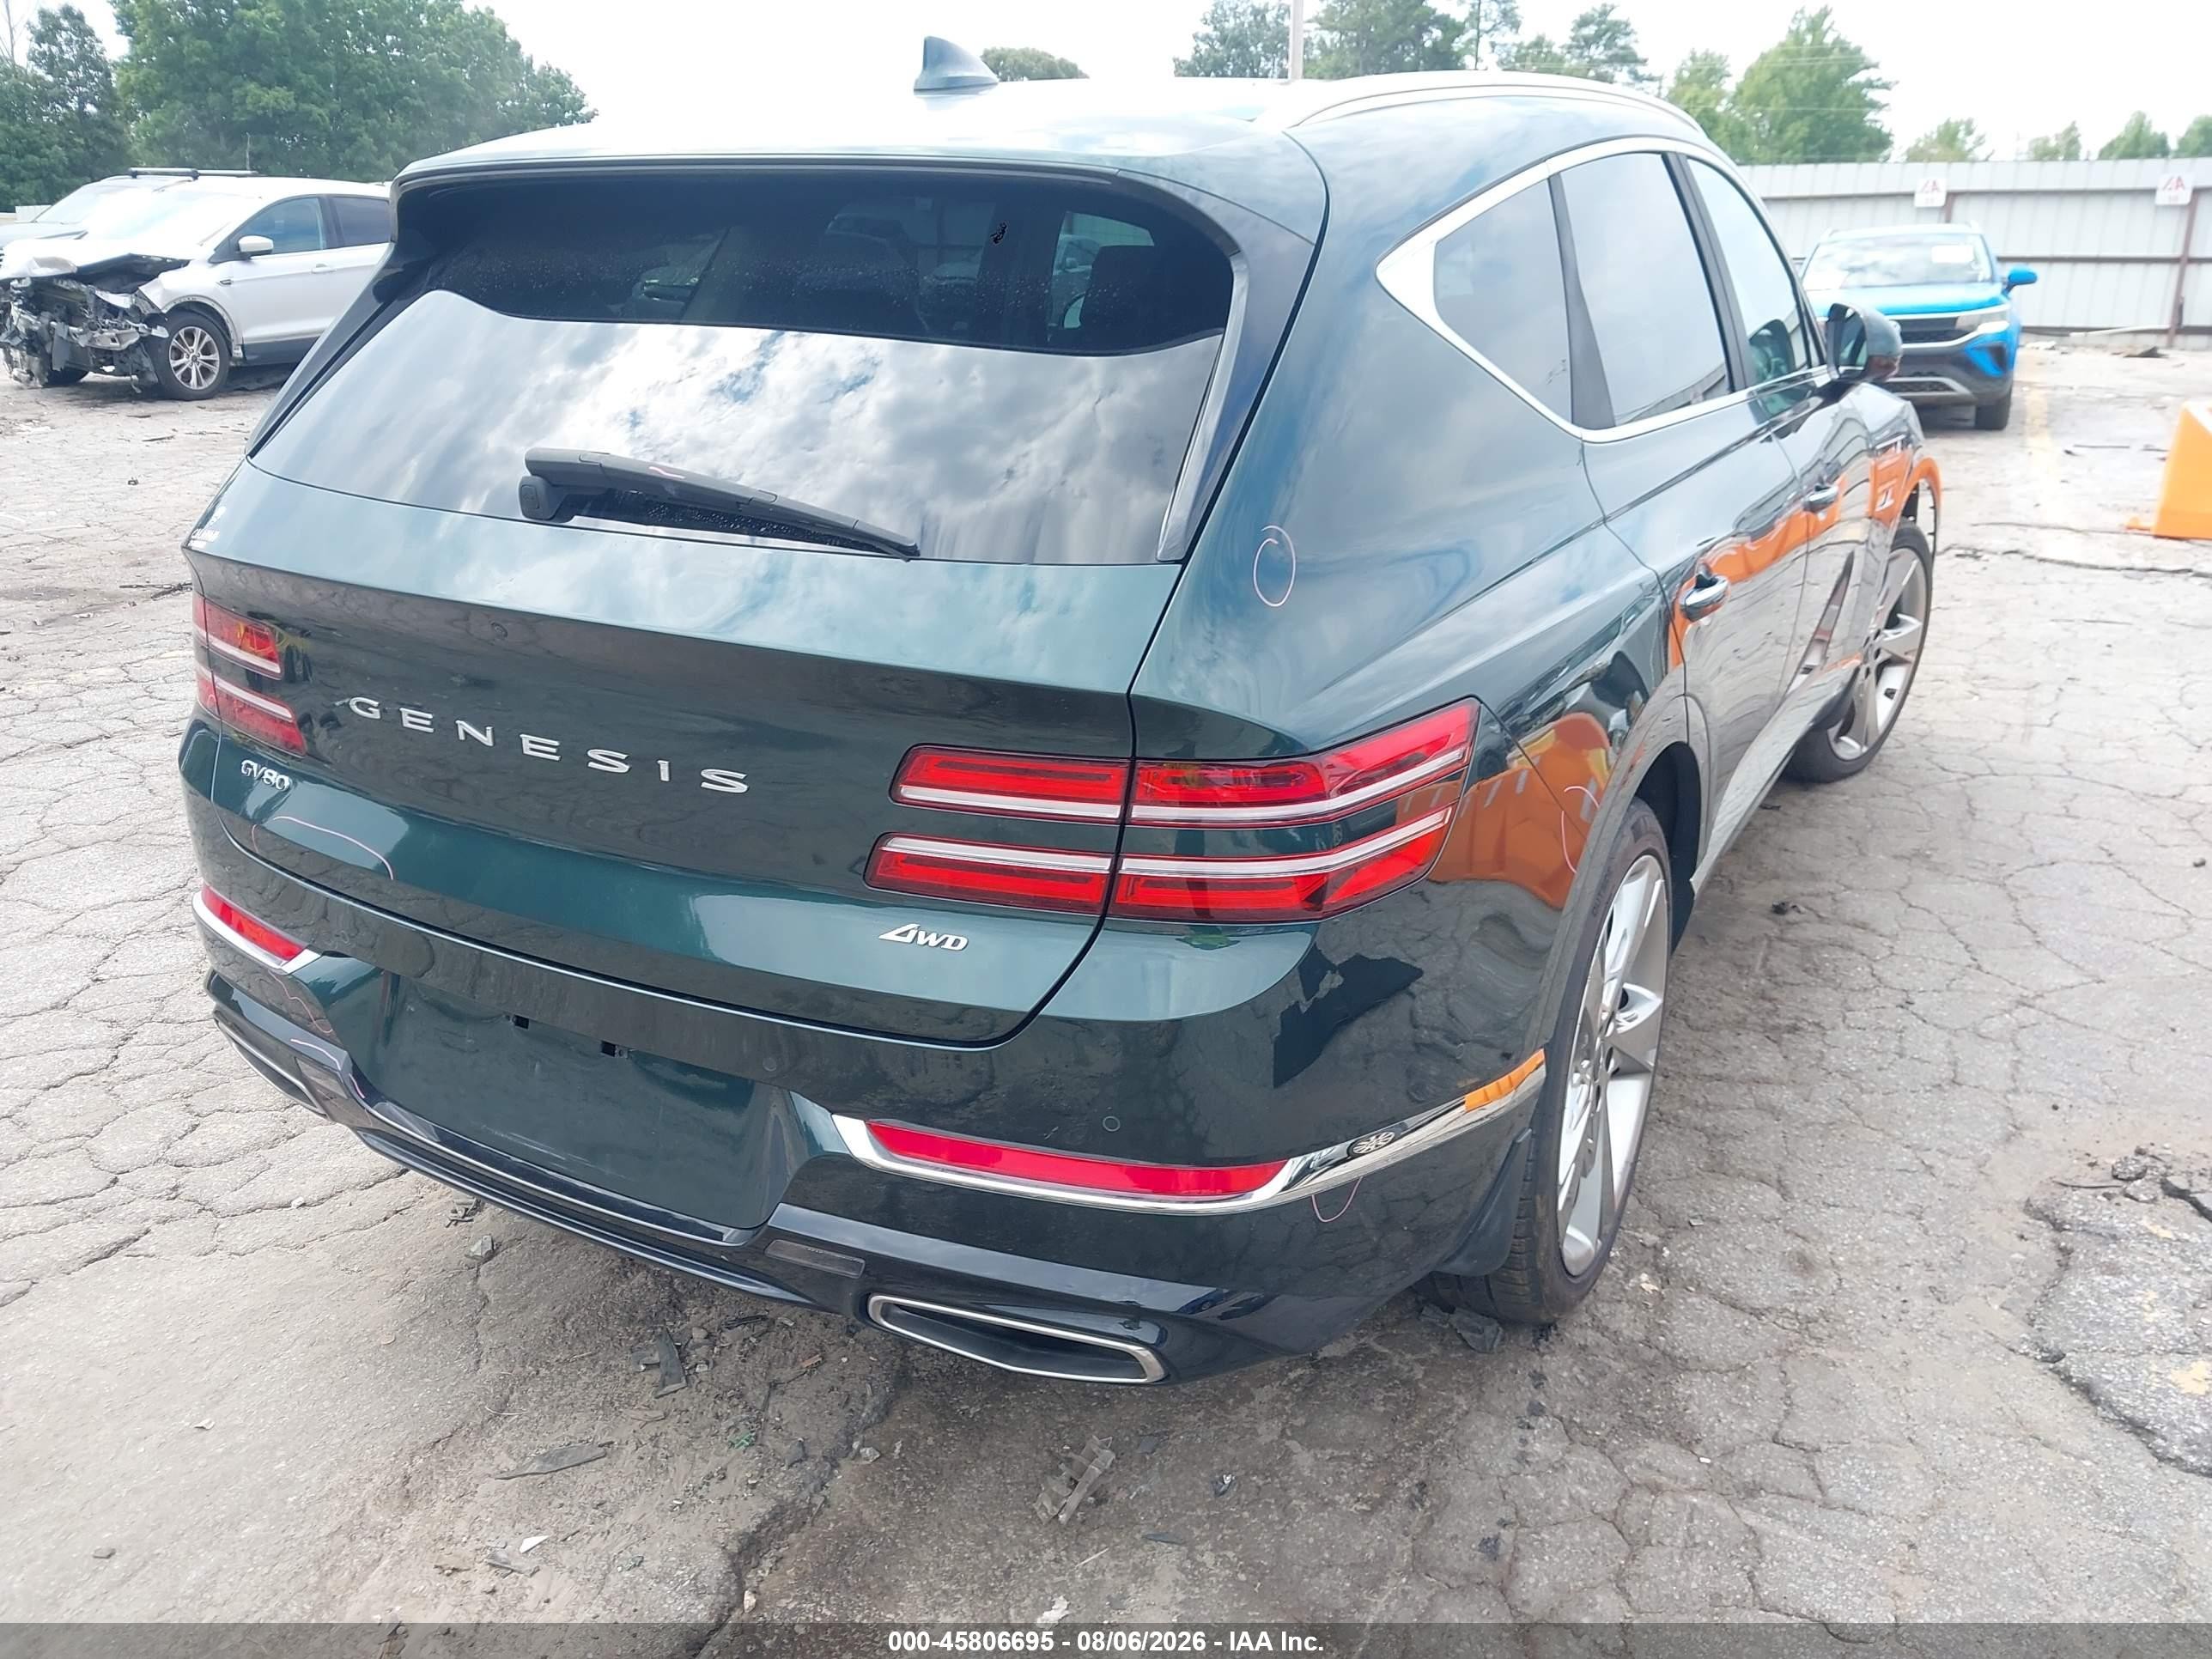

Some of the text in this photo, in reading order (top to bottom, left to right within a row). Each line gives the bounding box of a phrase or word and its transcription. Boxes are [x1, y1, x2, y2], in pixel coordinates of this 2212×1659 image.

[349, 696, 749, 793] GENESIS
[241, 759, 290, 791] GV80
[878, 923, 969, 951] 4WD
